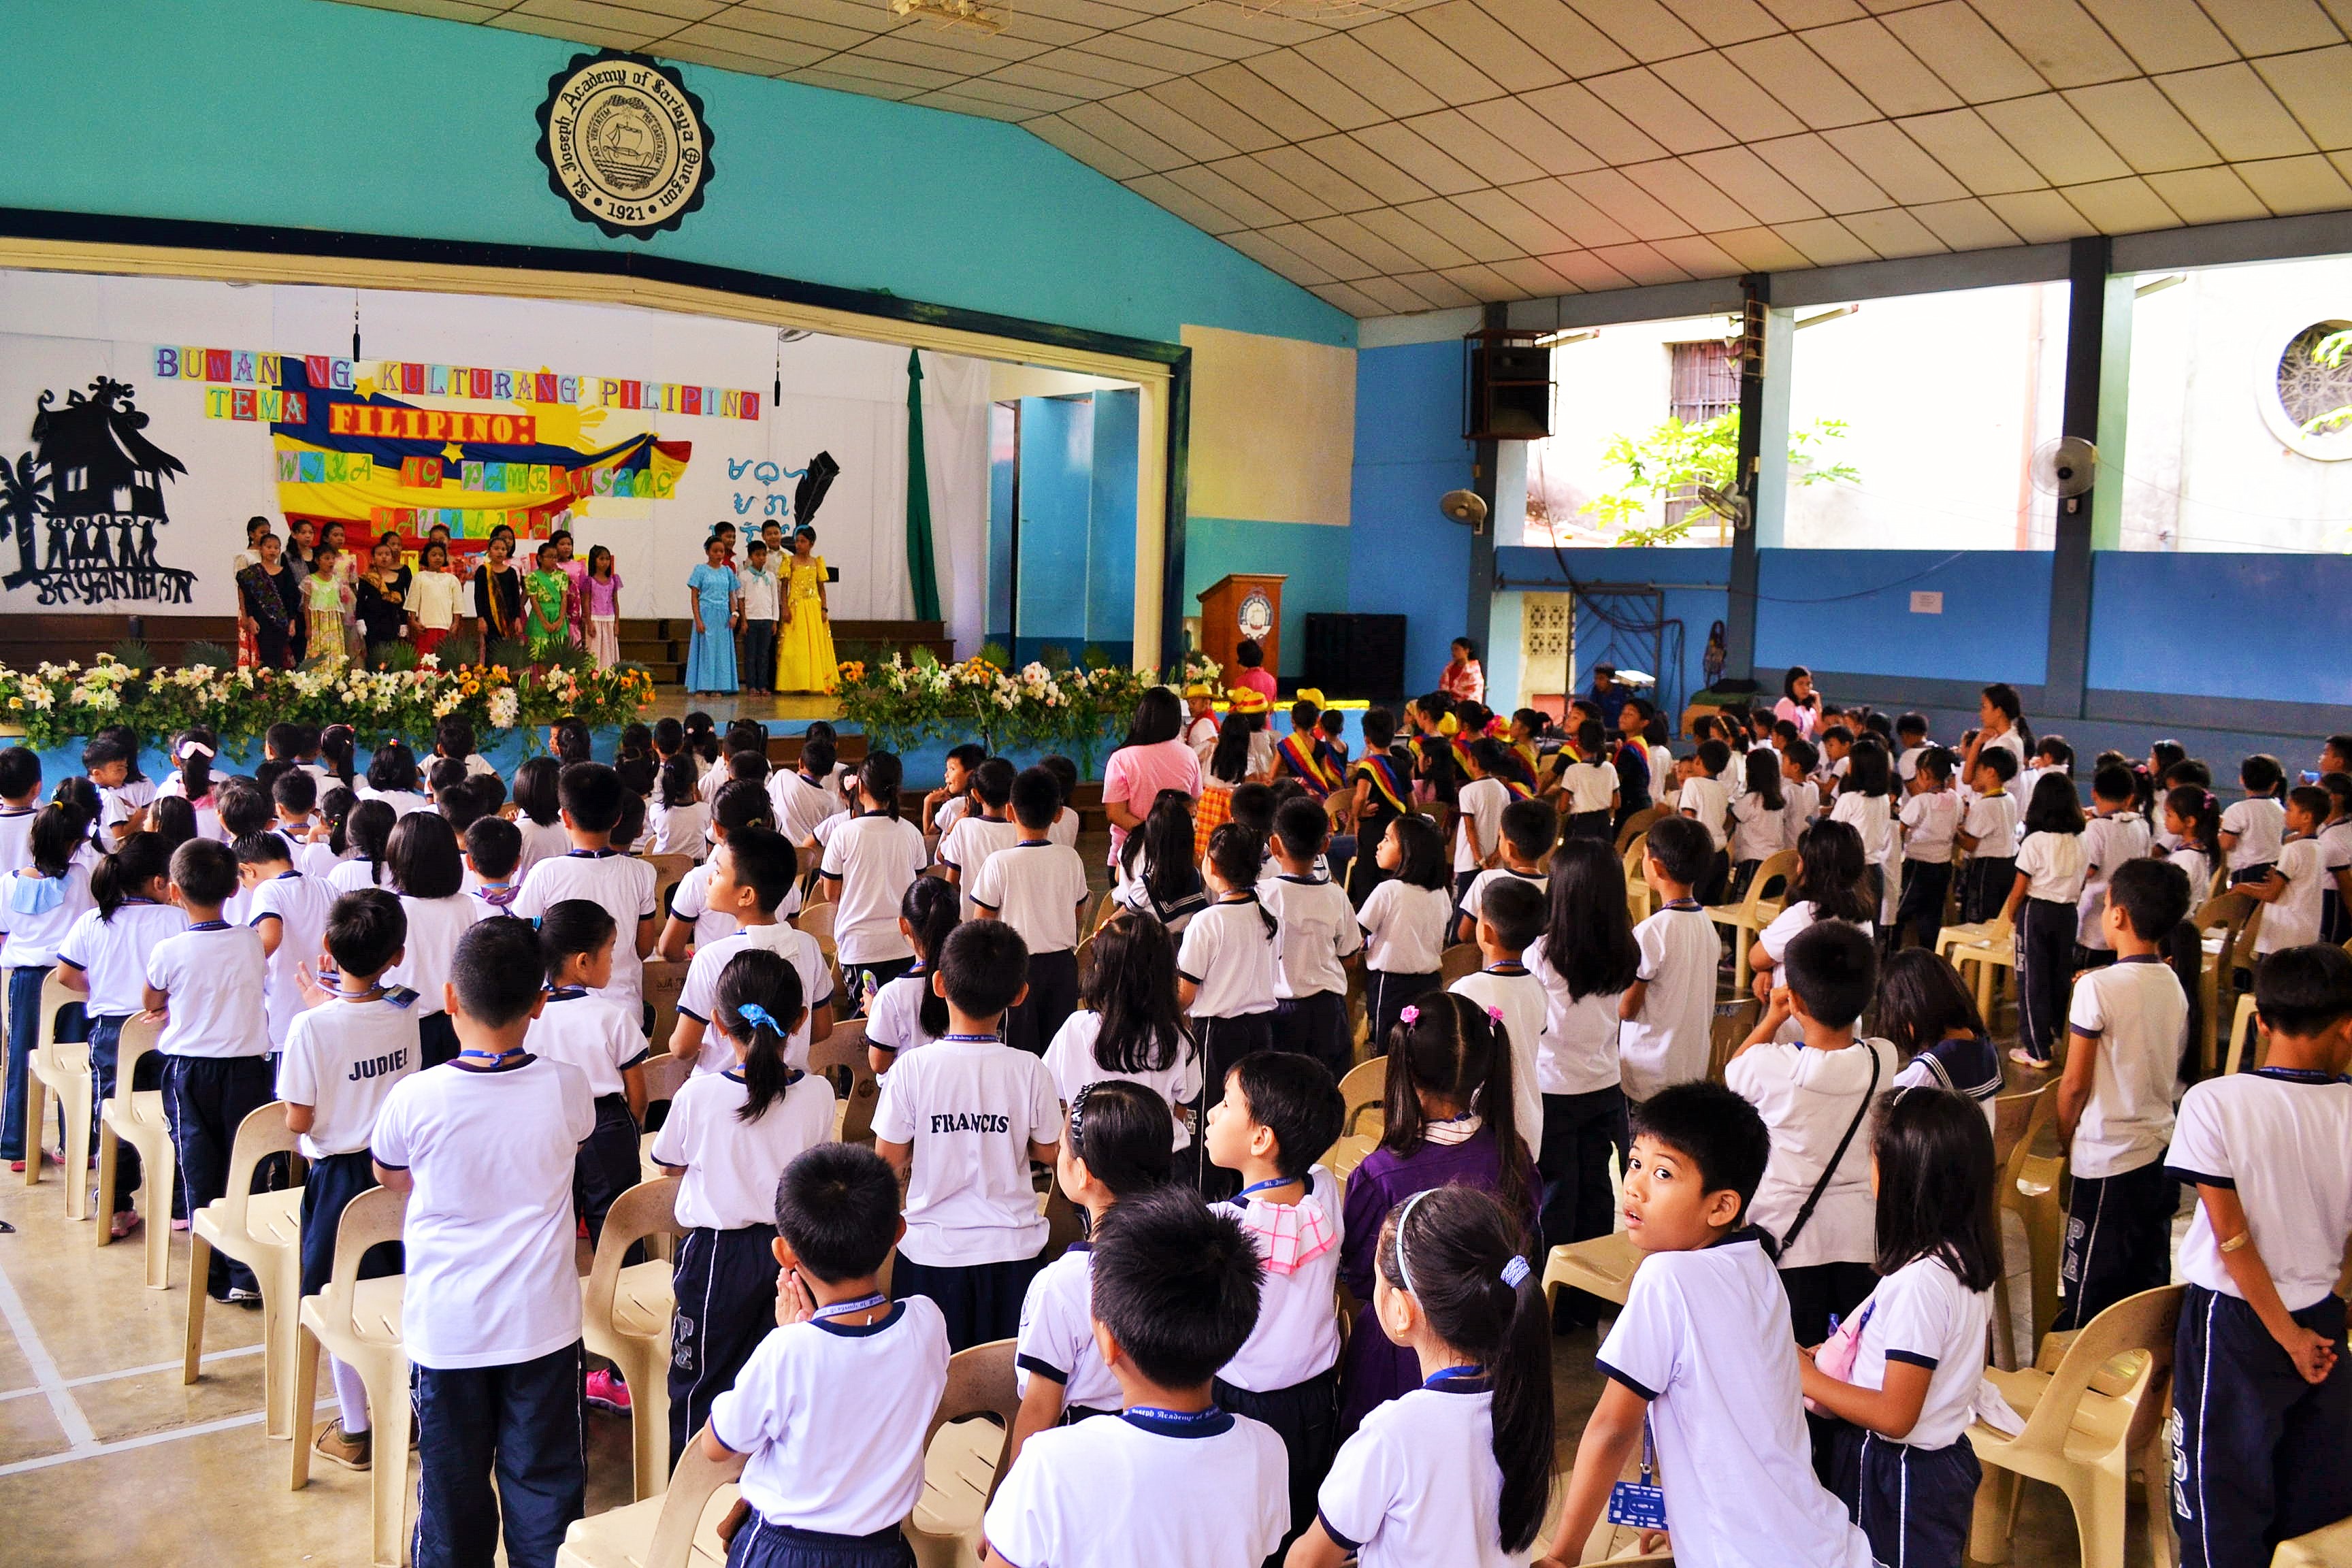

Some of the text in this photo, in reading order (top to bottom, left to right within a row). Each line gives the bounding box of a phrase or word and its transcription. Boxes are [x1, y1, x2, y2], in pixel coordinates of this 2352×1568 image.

[560, 69, 627, 115] Academy
[633, 72, 653, 88] of
[651, 78, 694, 143] Sariaya
[555, 115, 577, 176] Joseph
[659, 147, 700, 208] Quezon
[607, 202, 646, 221] 1921
[157, 348, 760, 419] BUWAN NG KULTURANG PILIPINO
[208, 388, 304, 422] TEMA
[348, 1047, 408, 1081] JUDIEL
[930, 1113, 1009, 1134] FRANCIS
[1158, 1411, 1194, 1422] Academy
